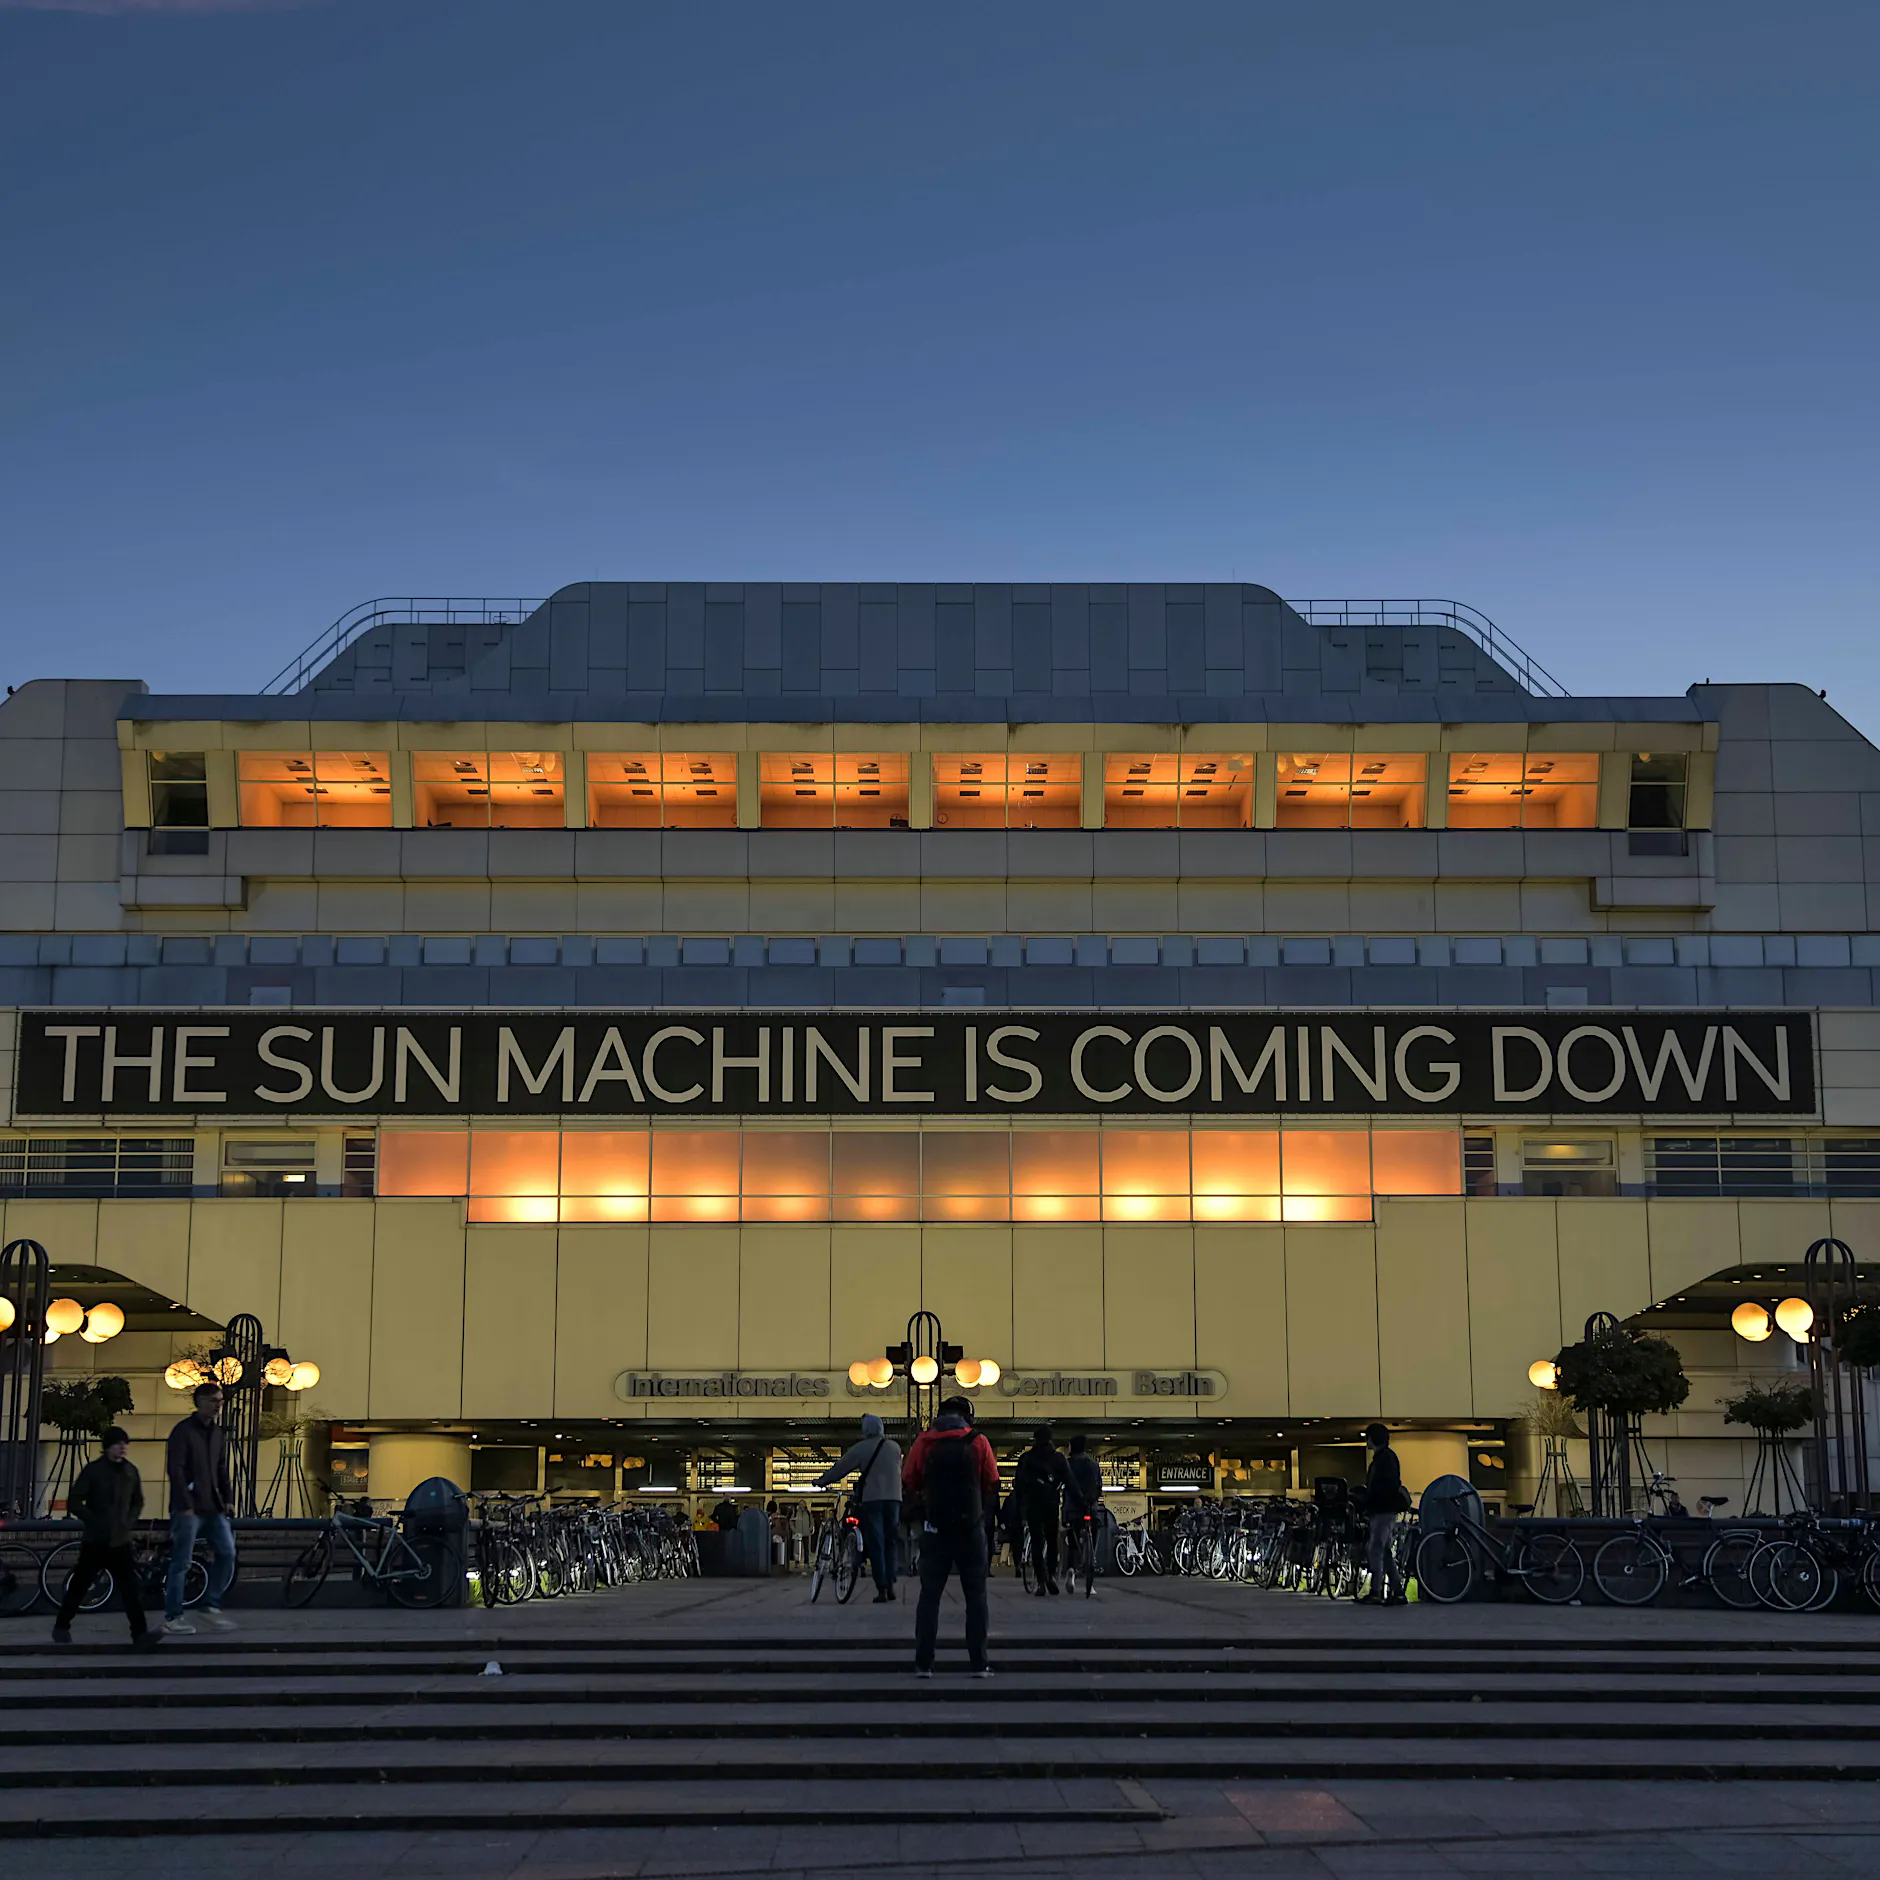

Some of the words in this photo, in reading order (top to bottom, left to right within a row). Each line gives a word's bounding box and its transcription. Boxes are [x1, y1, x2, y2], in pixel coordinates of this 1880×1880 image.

[45, 1026, 230, 1103] THE
[254, 1025, 462, 1103] SUN
[498, 1025, 935, 1103] MACHINE
[966, 1025, 1042, 1103] IS
[1070, 1025, 1461, 1103] COMING
[1493, 1025, 1791, 1103] DOWN
[627, 1372, 830, 1397] Internationales
[996, 1371, 1118, 1397] Centrum
[1131, 1371, 1216, 1396] Berlin
[1161, 1467, 1207, 1479] ENTRANCE
[1113, 1506, 1129, 1514] CHECK
[1130, 1506, 1137, 1514] IN
